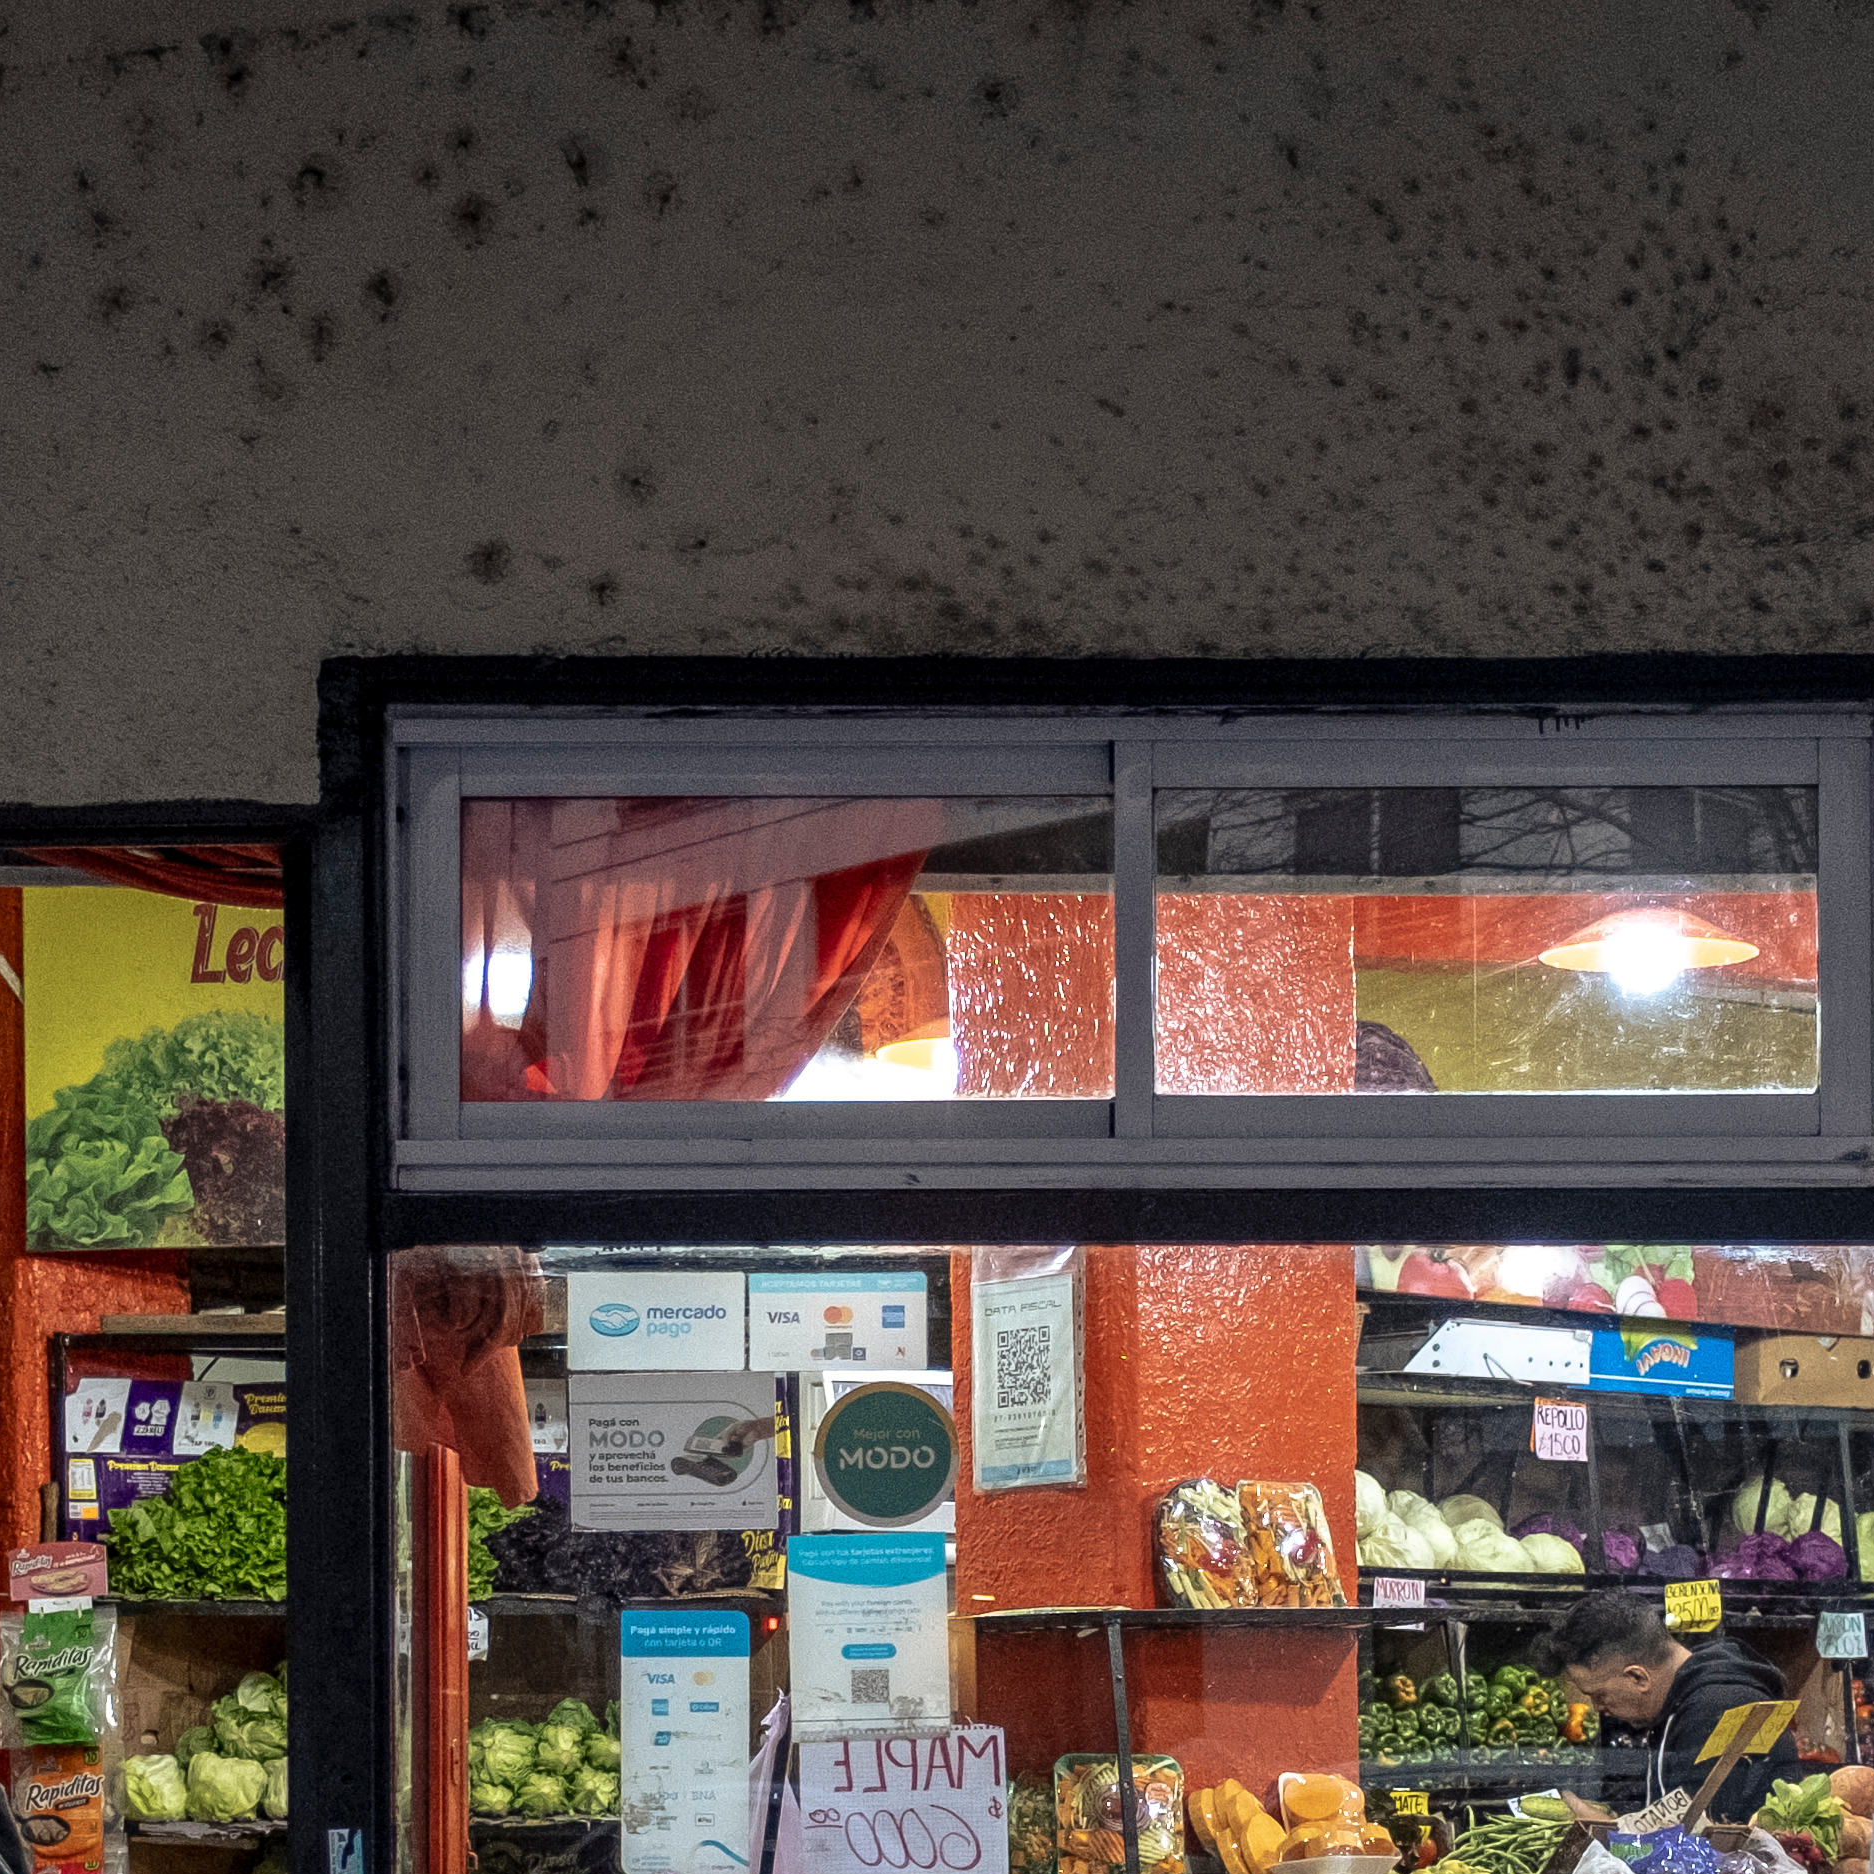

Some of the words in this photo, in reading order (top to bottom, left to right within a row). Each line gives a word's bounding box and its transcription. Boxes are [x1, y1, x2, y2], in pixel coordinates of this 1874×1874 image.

[646, 1304, 727, 1320] mercado
[984, 1305, 1017, 1317] DATA
[1020, 1299, 1063, 1312] FISCAL
[767, 1311, 800, 1324] VISA
[646, 1320, 692, 1337] pago
[1635, 1343, 1691, 1377] INGAVI
[588, 1418, 616, 1429] Pagá
[619, 1418, 640, 1427] con
[1537, 1407, 1585, 1430] REPOLLO
[589, 1430, 666, 1449] MODO
[854, 1429, 891, 1441] Mejor
[895, 1429, 921, 1440] con
[598, 1450, 657, 1462] aprovechá
[839, 1446, 936, 1470] MODO
[589, 1461, 605, 1472] los
[607, 1461, 667, 1472] beneficios
[589, 1473, 603, 1484] de
[605, 1474, 624, 1484] tus
[630, 1625, 656, 1636] Pagá
[658, 1625, 693, 1636] simple
[694, 1627, 700, 1635] y
[702, 1625, 736, 1635] rápido
[13, 1646, 94, 1681] Rapiditas
[646, 1673, 676, 1685] VISA
[26, 1774, 104, 1812] Rapiditas
